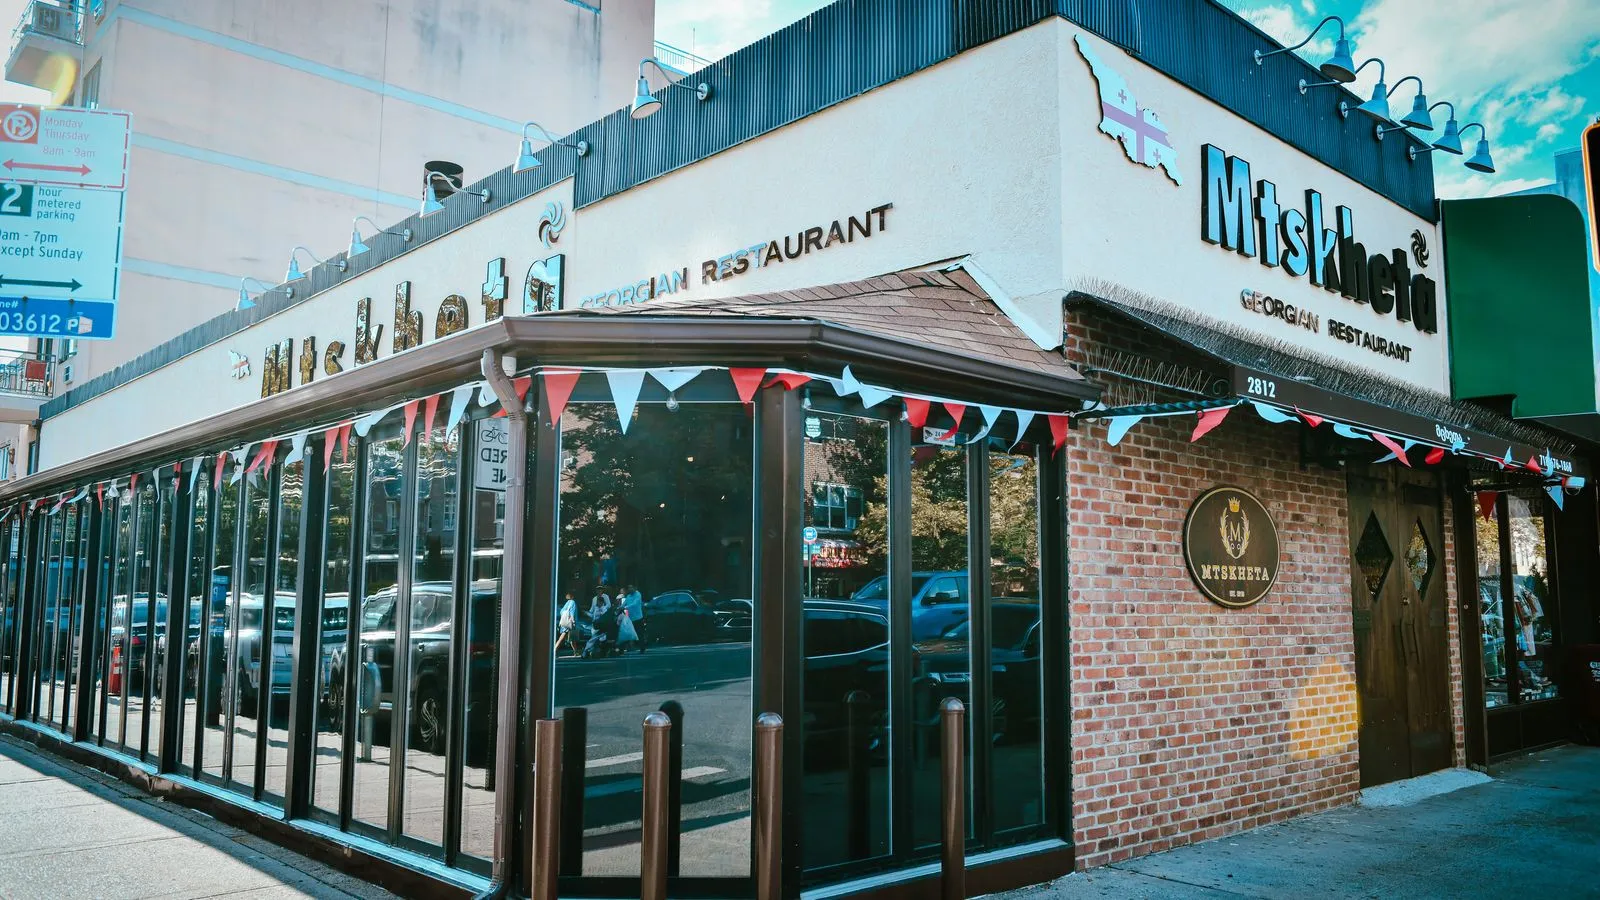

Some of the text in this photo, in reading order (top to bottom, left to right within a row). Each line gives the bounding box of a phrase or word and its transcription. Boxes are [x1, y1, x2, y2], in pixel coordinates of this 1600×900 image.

[45, 116, 83, 128] Monday
[45, 128, 90, 141] Thursday
[43, 145, 64, 156] 8am
[74, 147, 96, 158] 9am
[1, 183, 23, 213] 2
[39, 187, 62, 197] hour
[38, 199, 81, 210] metered
[37, 210, 75, 222] parking
[0, 229, 20, 241] am
[33, 231, 58, 244] 7pm
[1201, 143, 1437, 334] Mtskheta
[0, 246, 84, 261] xcept Sunday
[578, 202, 893, 308] GEORGIAN RESTAURANT
[0, 301, 19, 309] ne#
[0, 312, 61, 333] 03612
[261, 254, 565, 398] Mtskheta
[1240, 289, 1412, 363] GEORGIAN RESTAURANT
[1247, 376, 1276, 398] 2812
[1201, 564, 1270, 581] MTSKHETA
